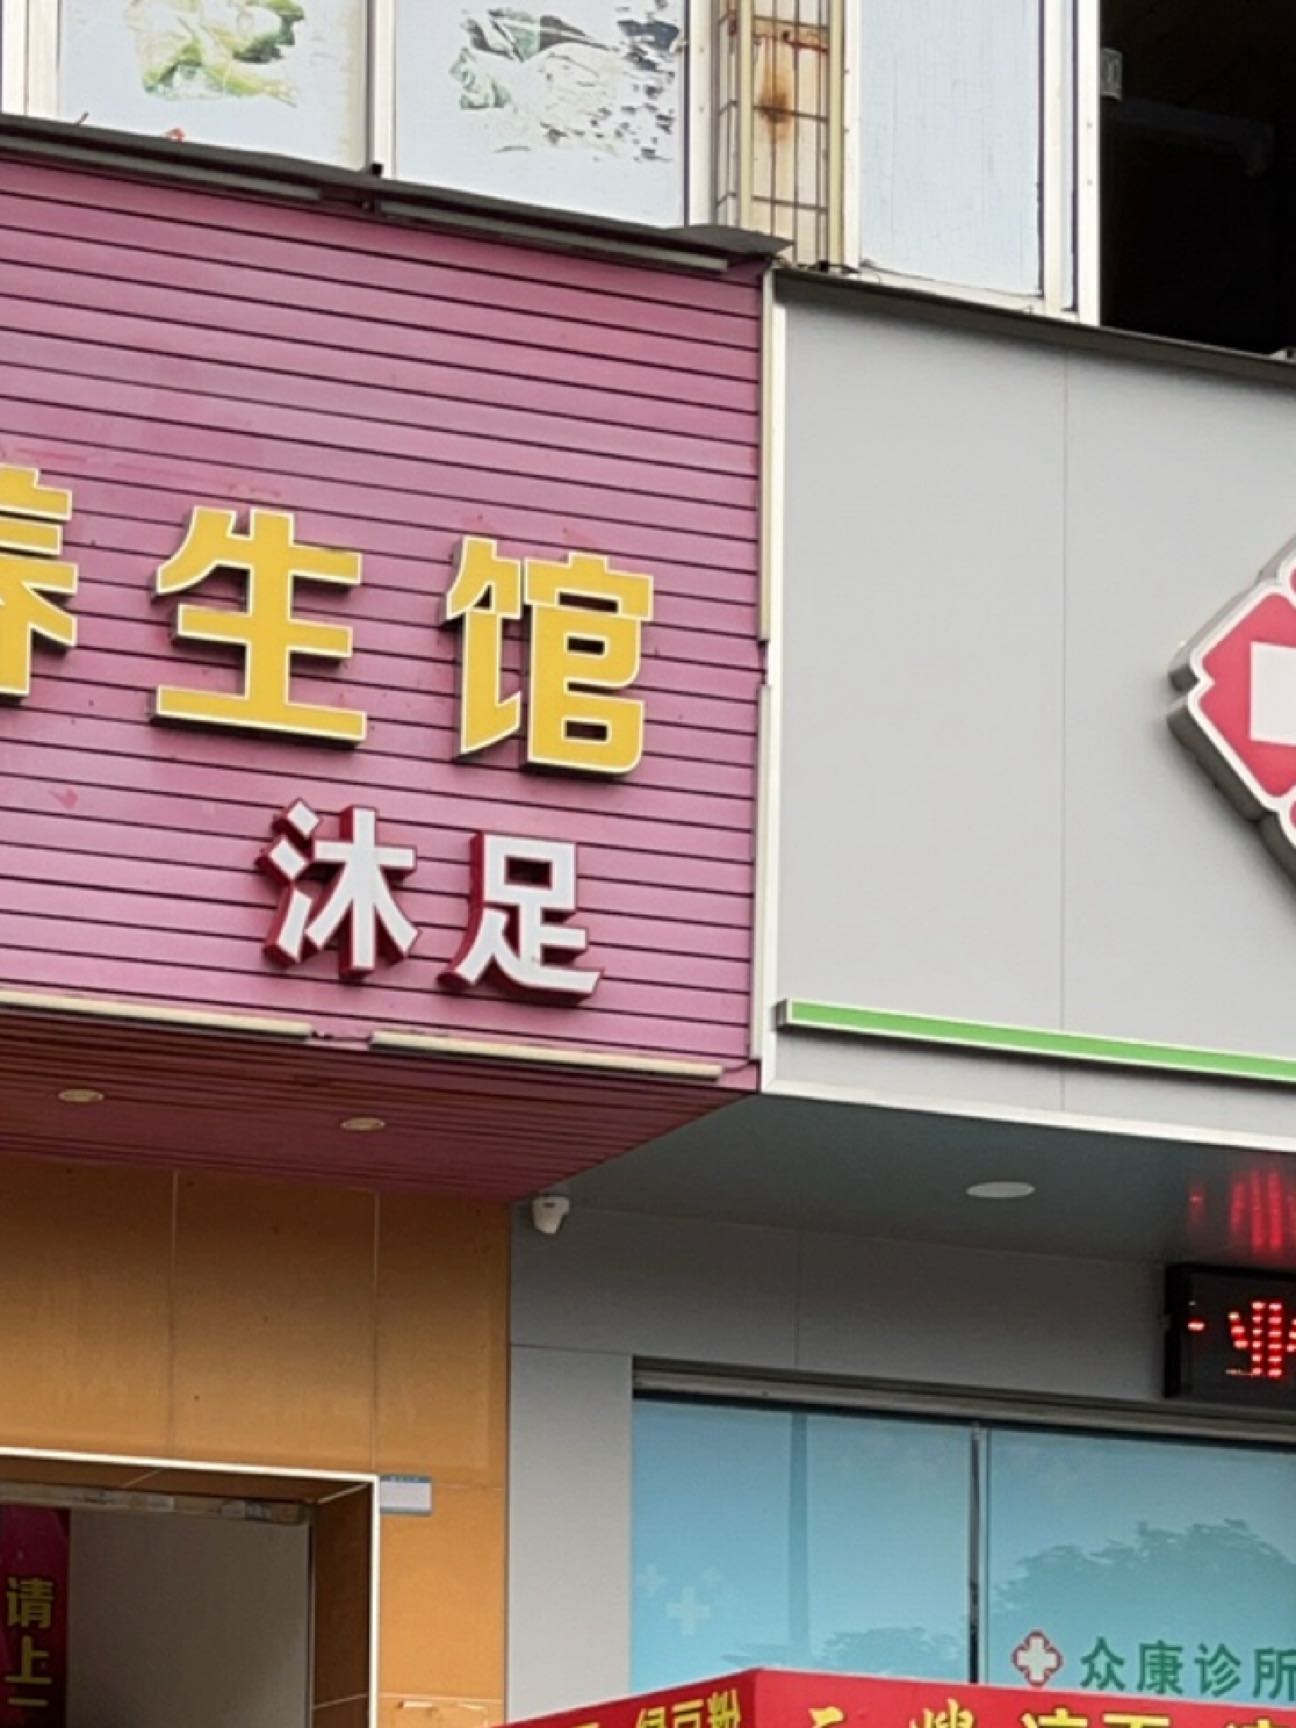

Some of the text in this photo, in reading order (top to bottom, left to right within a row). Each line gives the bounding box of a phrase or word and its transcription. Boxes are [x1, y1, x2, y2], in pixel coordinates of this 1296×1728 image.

[257, 798, 602, 998] 沐足
[1080, 1636, 1296, 1702] 众康诊所
